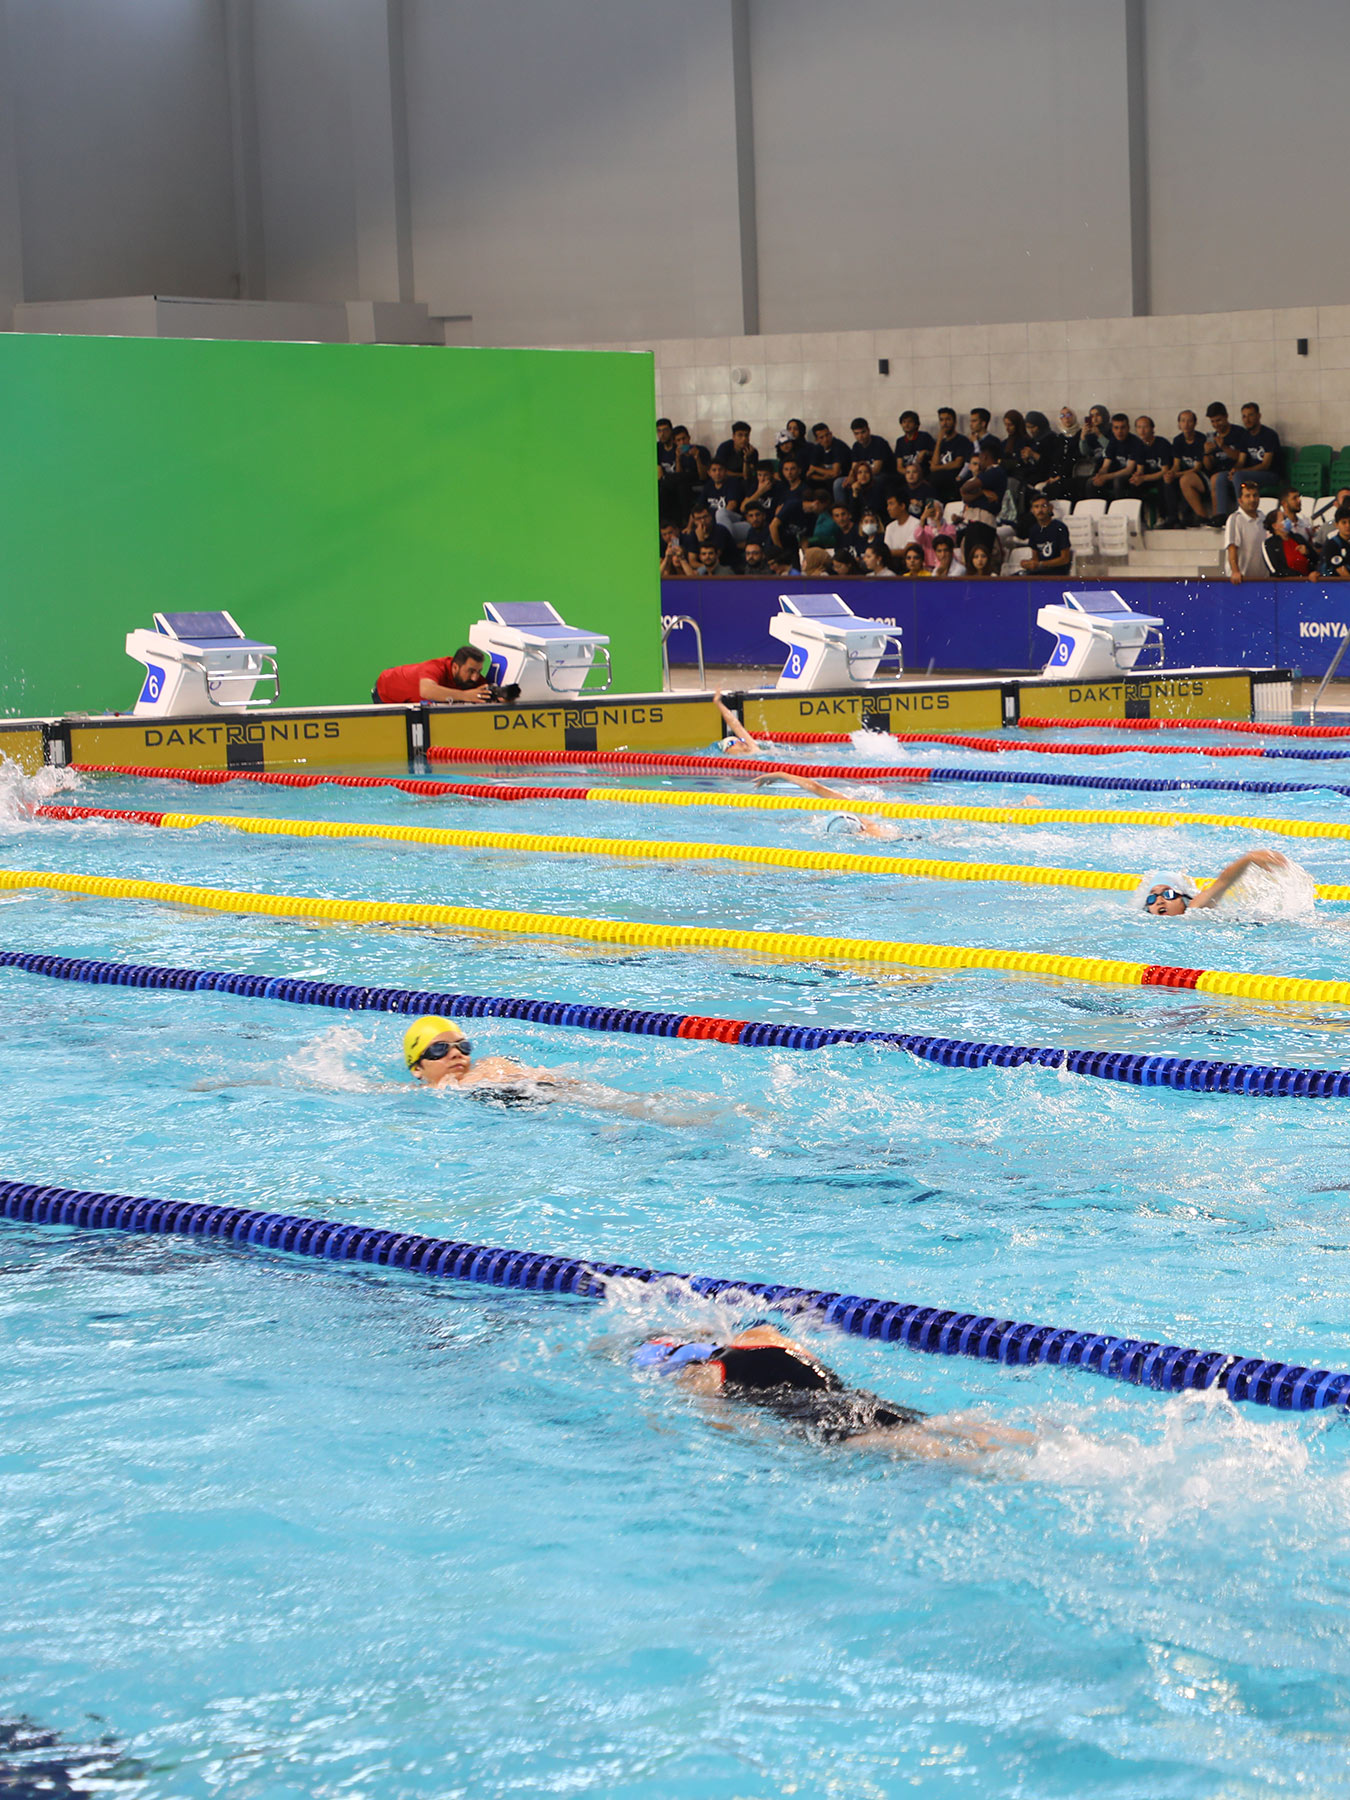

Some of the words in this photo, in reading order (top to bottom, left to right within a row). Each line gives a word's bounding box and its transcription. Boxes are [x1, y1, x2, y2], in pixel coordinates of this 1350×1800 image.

[1300, 622, 1350, 638] KONYA
[1059, 643, 1068, 662] 9
[492, 663, 500, 685] 7
[792, 654, 801, 675] 8
[149, 675, 159, 698] 6
[1069, 682, 1204, 703] DAKTRONICS
[800, 694, 950, 716] DAKTRONICS
[494, 707, 664, 730] DAKTRONICS
[145, 721, 340, 747] DAKTRONICS
